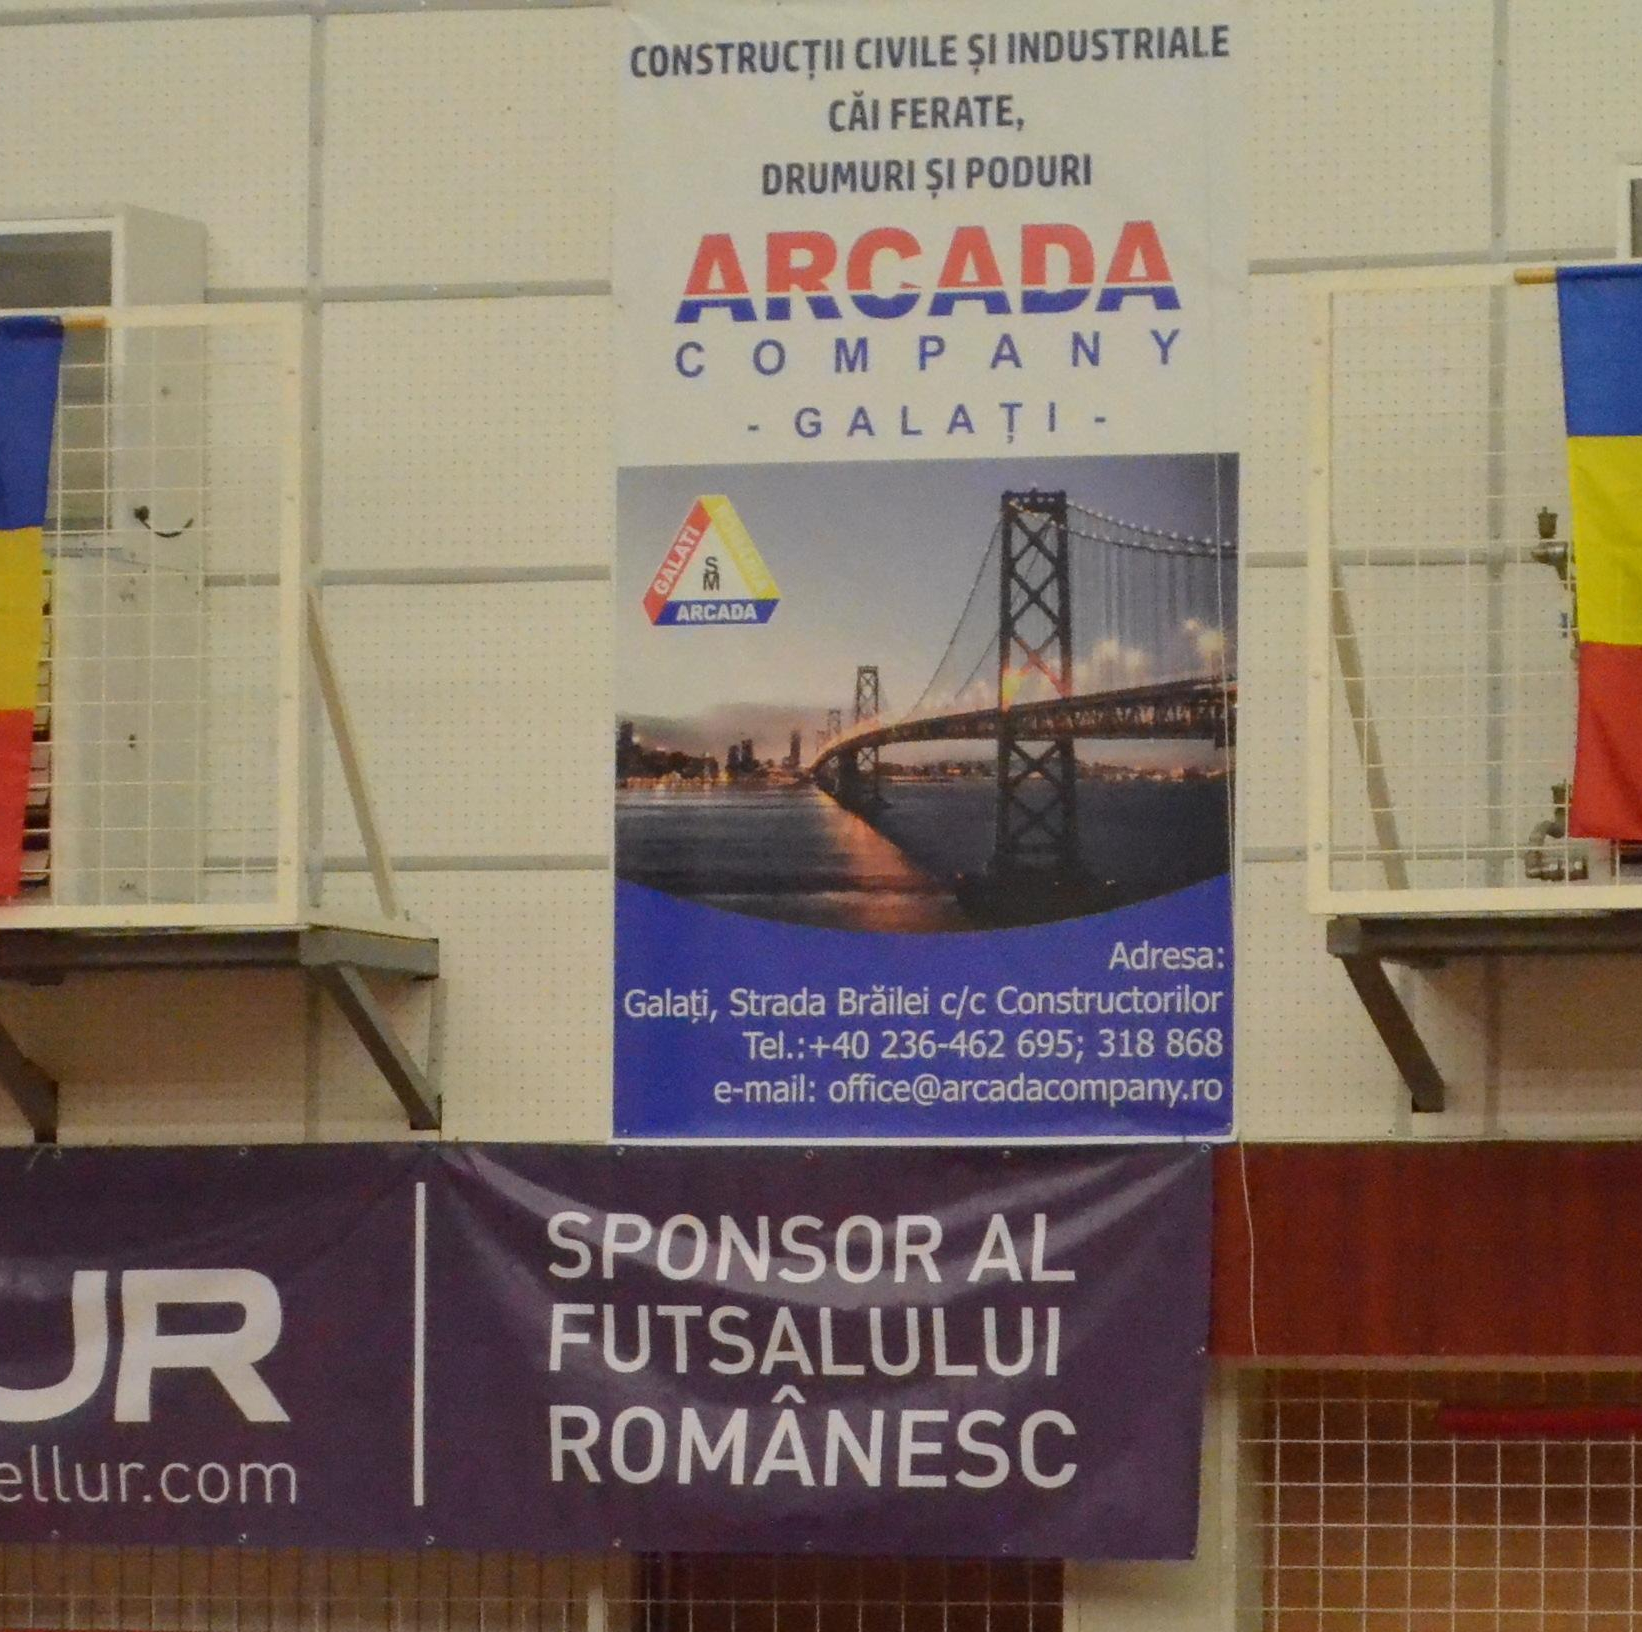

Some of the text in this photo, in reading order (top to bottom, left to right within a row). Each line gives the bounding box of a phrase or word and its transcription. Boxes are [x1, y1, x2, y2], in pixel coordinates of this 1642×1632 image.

[629, 25, 1229, 81] CONSTRUCȚII CIVILE ȘI INDUSTRIALE
[828, 90, 1025, 133] CĂI FERATE,
[762, 154, 1092, 199] DRUMURI ȘI PODURI
[674, 220, 1181, 324] ARCADA
[674, 328, 1181, 379] COMPANY
[676, 604, 757, 622] ARCADA
[1109, 941, 1226, 970] Adresa:
[623, 984, 1224, 1025] Galați, Strada Brăilei c/c Constructorilor
[742, 1029, 1224, 1064] Tel.:+40 236-462 695; 318 868
[713, 1076, 1224, 1109] e-mail: office@arcadacompany.ro
[547, 1211, 1076, 1284] SPONSOR AL
[547, 1303, 1061, 1377] FUTSALULUI
[548, 1384, 1077, 1490] ROMÂNESC
